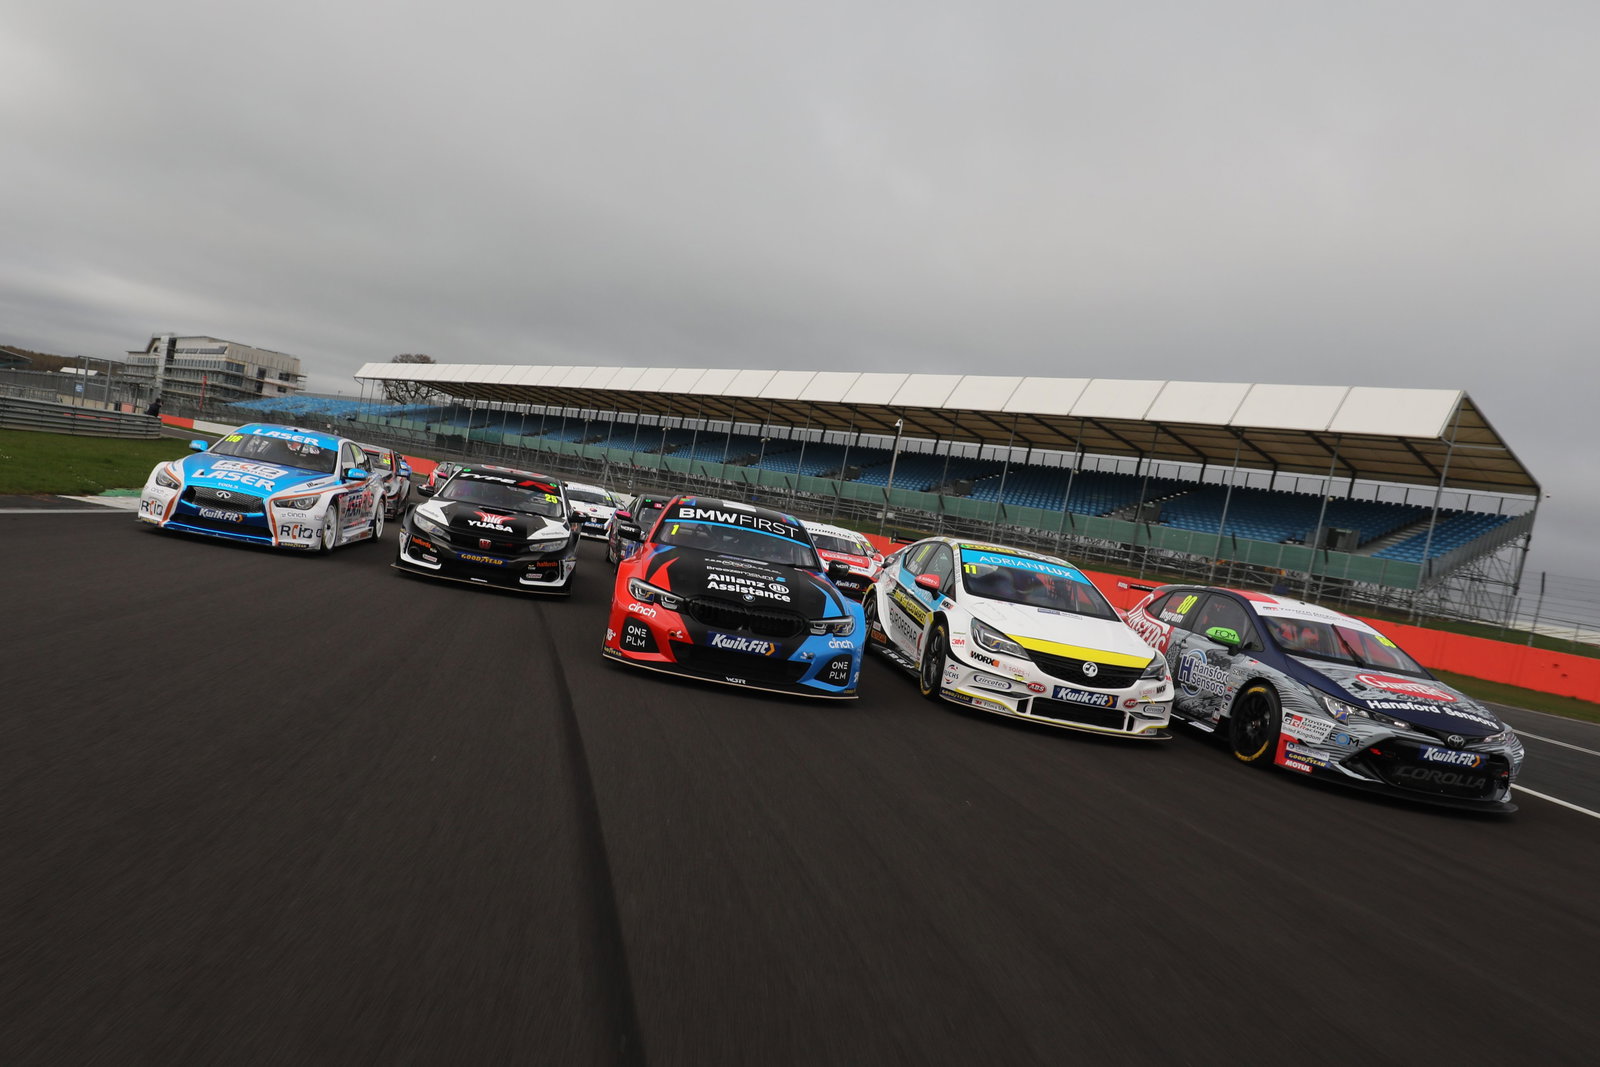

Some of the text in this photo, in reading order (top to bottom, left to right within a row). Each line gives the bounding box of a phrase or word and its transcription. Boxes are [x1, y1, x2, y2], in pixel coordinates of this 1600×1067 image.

[225, 435, 243, 443] 116
[253, 429, 319, 447] LASER
[191, 468, 276, 492] LASER
[460, 473, 517, 484] TYPE
[544, 493, 558, 504] 25
[468, 519, 514, 533] YUASA
[671, 524, 680, 535] 1
[461, 553, 503, 565] GOODYEAR
[963, 564, 977, 574] 11
[707, 573, 766, 588] Allianz
[707, 580, 791, 603] Assistance
[628, 602, 657, 618] cinch
[1176, 595, 1198, 615] 80
[1159, 608, 1184, 623] Ingram
[627, 625, 647, 638] ONE
[1214, 629, 1236, 640] EOM
[625, 635, 646, 648] PLM
[828, 638, 854, 649] cinch
[952, 638, 965, 646] 3M
[970, 650, 995, 667] WORX
[831, 661, 849, 670] ONE
[829, 671, 847, 680] PLM
[979, 677, 1007, 688] zircotec
[1191, 673, 1224, 695] Sensors
[941, 689, 970, 701] GOODYEAR
[1366, 700, 1500, 730] Hansford Sensors
[1302, 721, 1328, 732] GAZOO
[1304, 718, 1332, 729] TOYOTA
[1296, 730, 1321, 741] Kingdom
[1285, 760, 1311, 772] MOTUL
[1288, 753, 1326, 767] GOODYEAR
[1394, 765, 1487, 789] COROLLA
